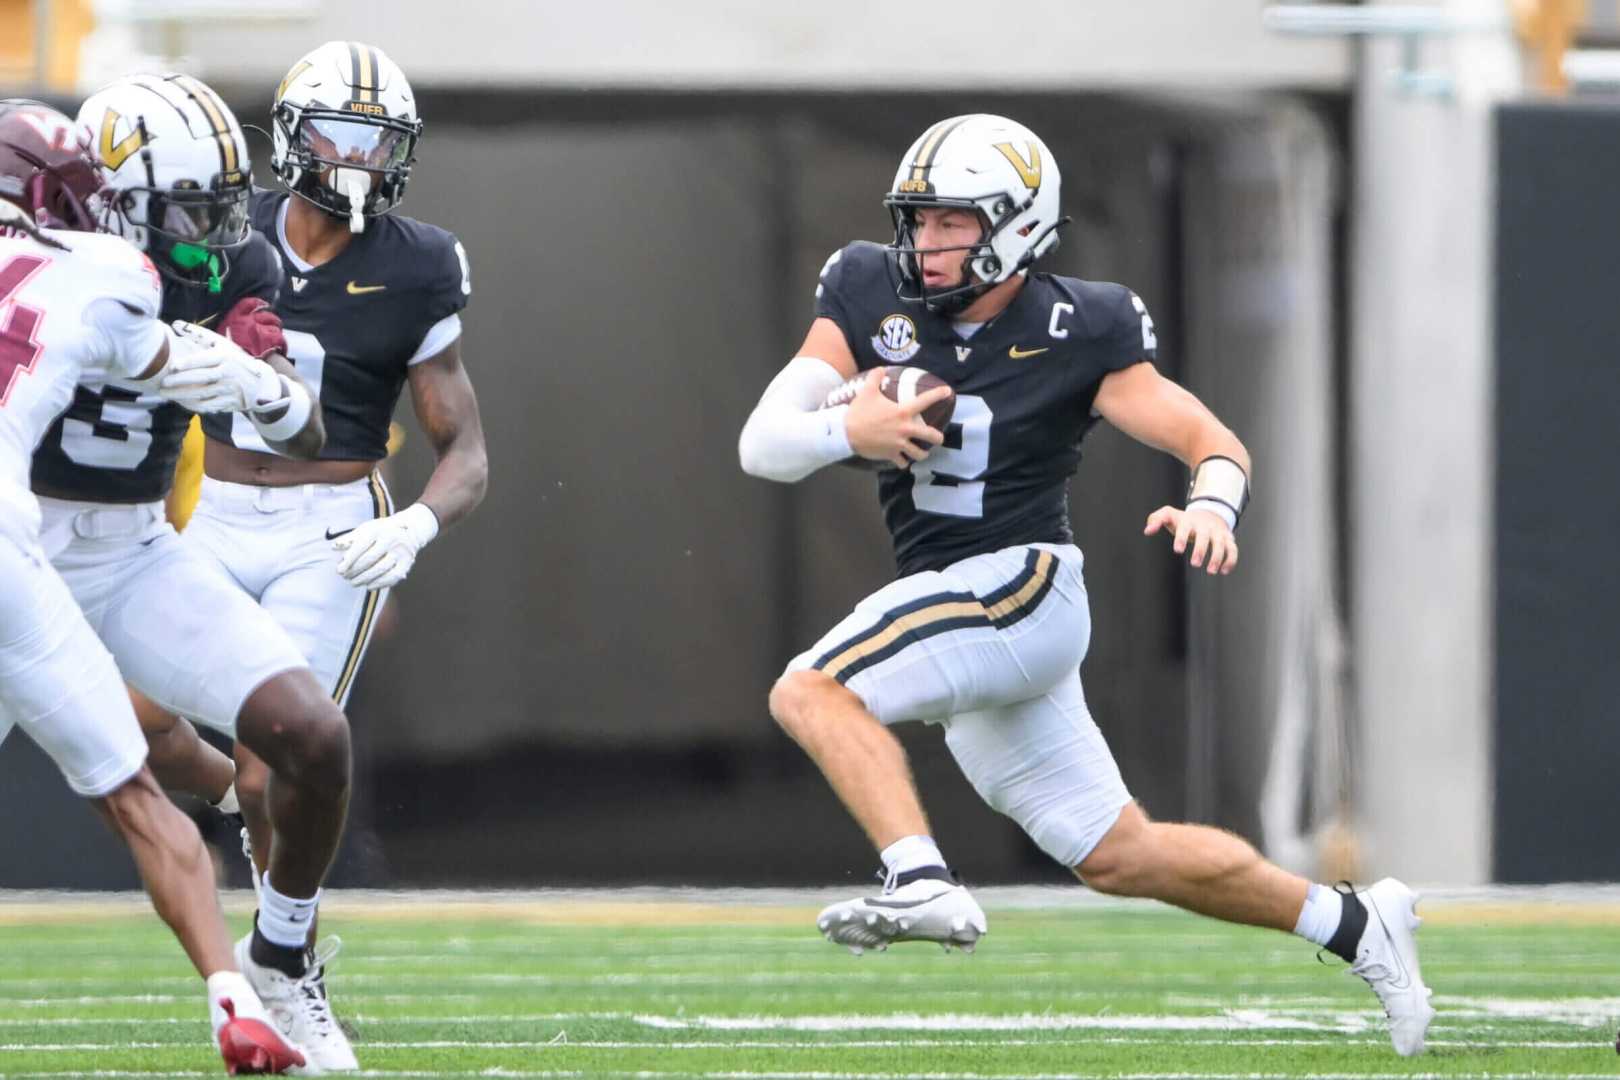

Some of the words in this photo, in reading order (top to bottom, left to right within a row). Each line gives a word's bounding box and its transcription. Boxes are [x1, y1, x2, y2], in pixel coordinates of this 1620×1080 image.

[991, 141, 1042, 189] V
[291, 276, 308, 292] V
[881, 317, 913, 350] SEC
[1048, 302, 1075, 338] C
[955, 345, 972, 362] V
[910, 394, 994, 517] 2
